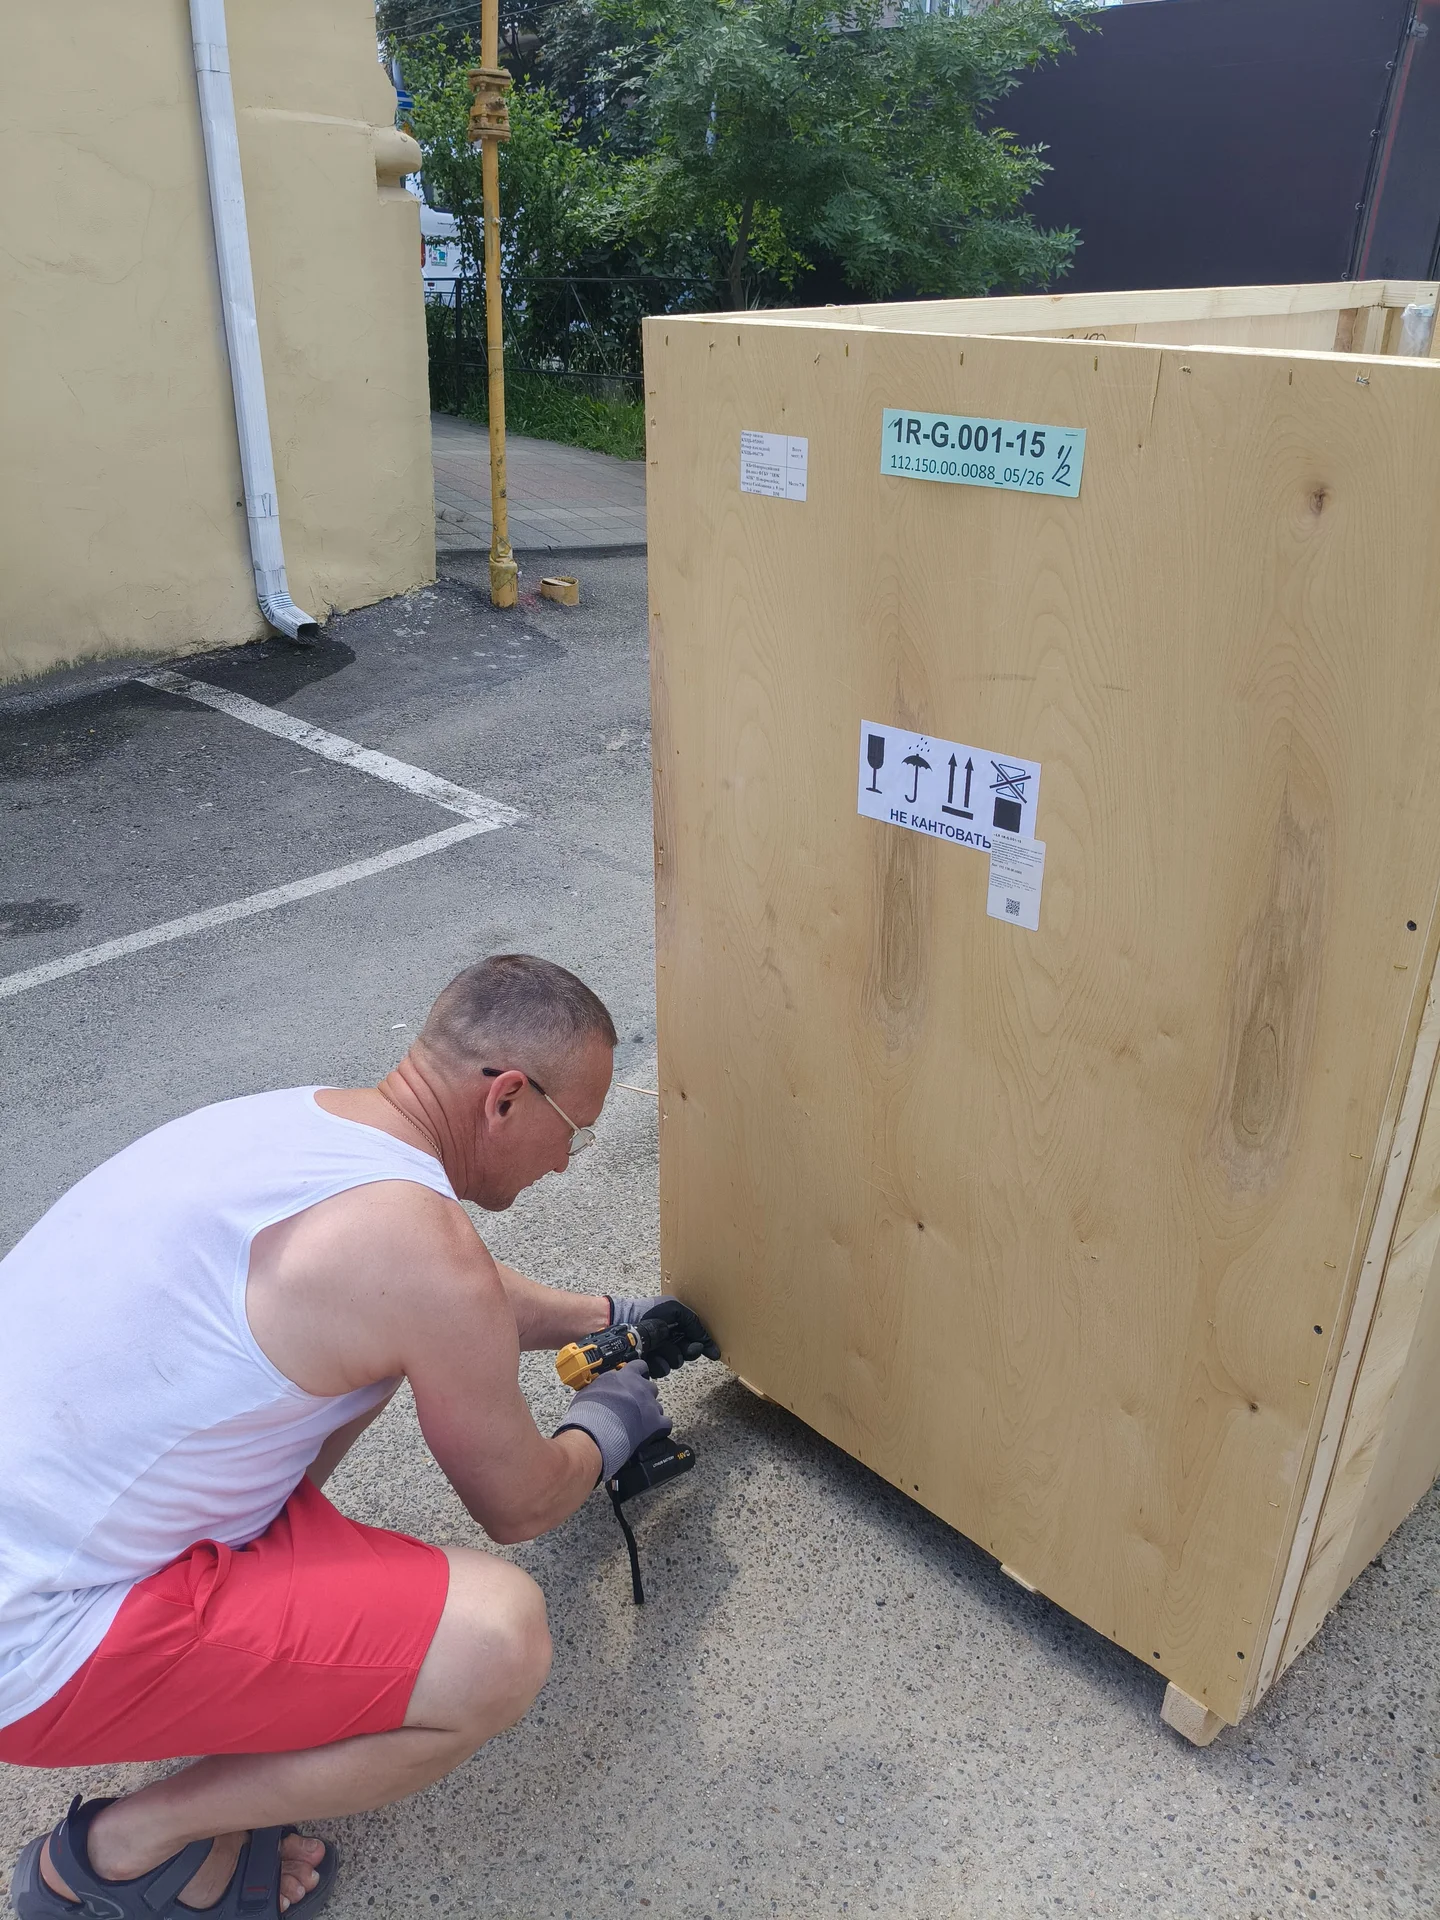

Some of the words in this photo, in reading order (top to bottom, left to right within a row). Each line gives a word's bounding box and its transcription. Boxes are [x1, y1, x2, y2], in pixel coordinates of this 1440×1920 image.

[893, 417, 1046, 458] 1R-G.001-15
[891, 454, 1045, 487] 112.150.00.0088_05/26
[890, 808, 908, 824] НЕ
[911, 814, 992, 849] КАНТОВАТЬ
